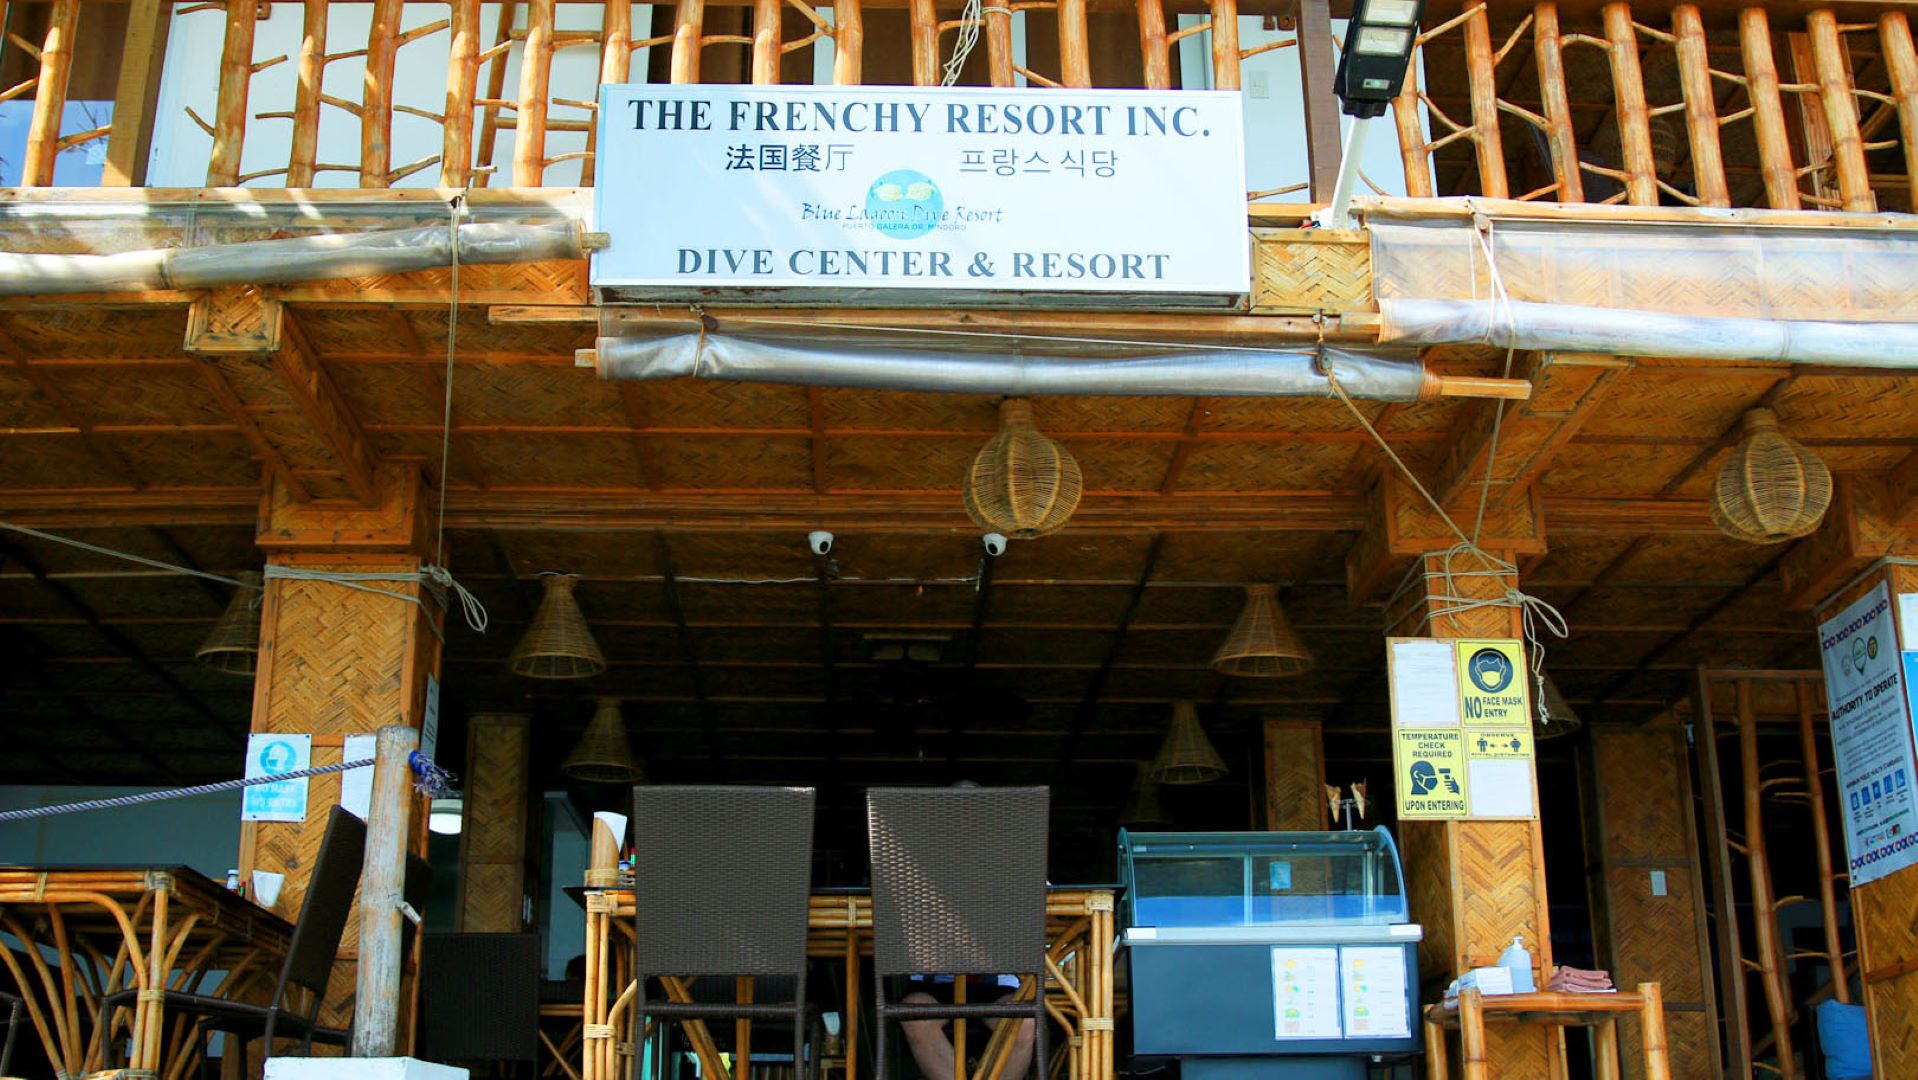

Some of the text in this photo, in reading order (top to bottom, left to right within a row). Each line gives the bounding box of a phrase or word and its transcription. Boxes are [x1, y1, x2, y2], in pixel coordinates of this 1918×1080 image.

[628, 99, 1212, 137] THE FRENCHY RESORT INC.
[725, 144, 855, 173] 法国餐厅
[959, 149, 1119, 178] 프랑스 식당
[801, 202, 841, 221] Blue
[912, 204, 950, 222] Dive
[953, 206, 1005, 224] Resort
[842, 223, 874, 231] PUERTO
[677, 249, 1171, 280] DIVE CENTER & RESORT
[1832, 694, 1863, 721] AUTHORITY
[1864, 689, 1874, 703] TO
[1873, 672, 1898, 700] OPERATE
[1465, 697, 1523, 719] NO FACE MASK
[1485, 709, 1508, 718] ENTRY
[1401, 733, 1459, 741] TEMPERATURE
[1418, 742, 1446, 750] CHECK
[1412, 751, 1453, 759] REQUIRED
[1405, 800, 1465, 811] UPON ENTERING
